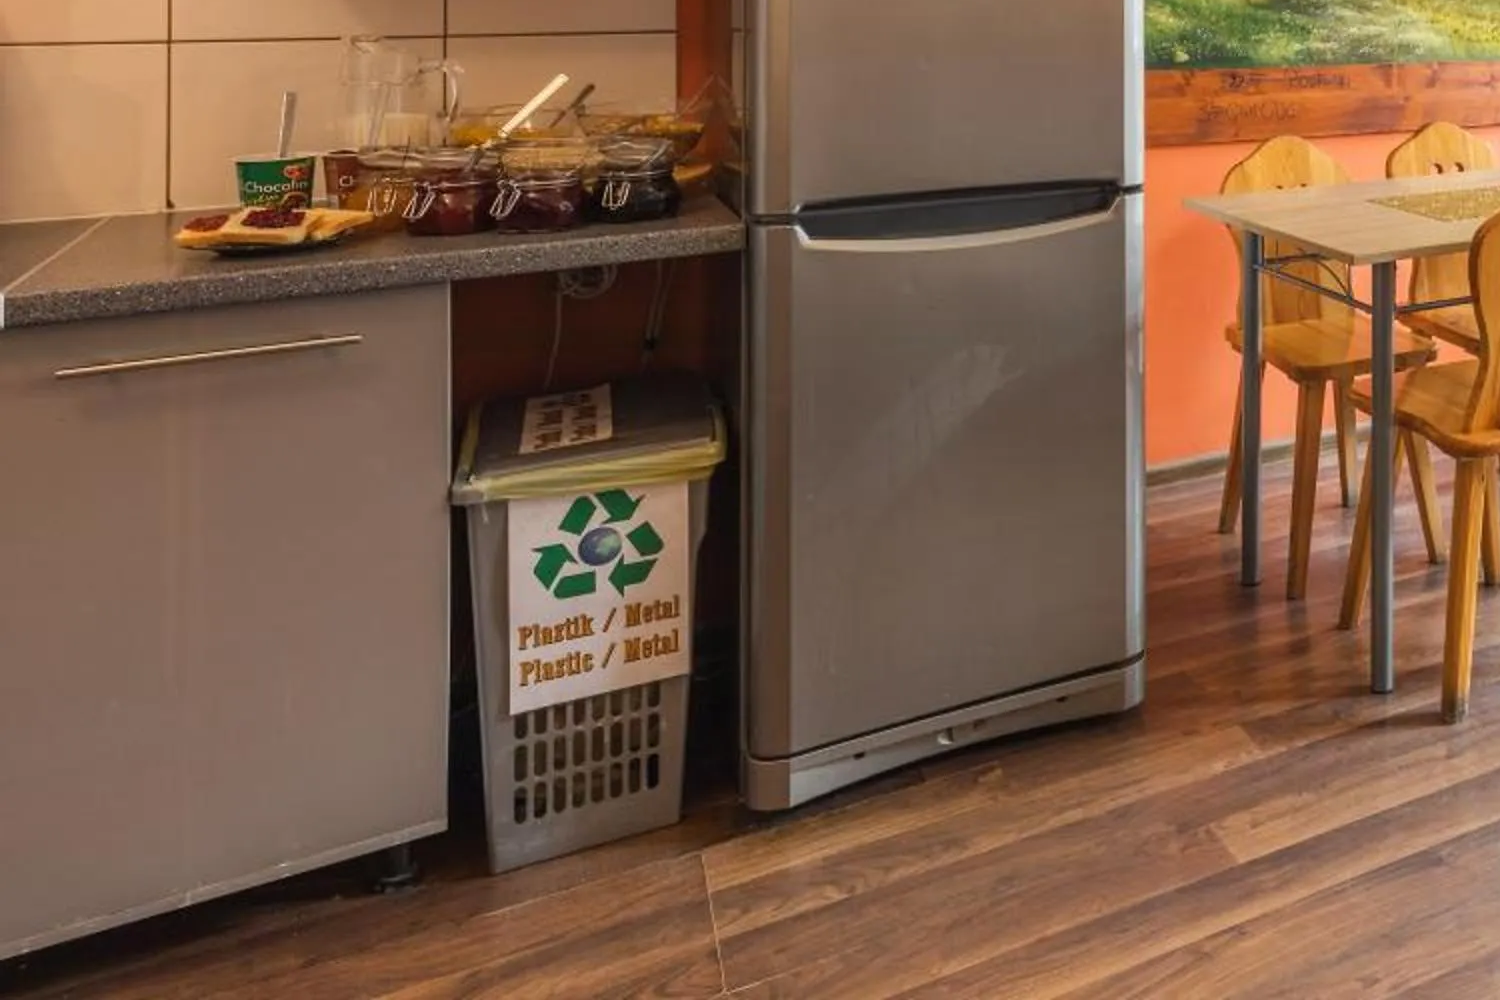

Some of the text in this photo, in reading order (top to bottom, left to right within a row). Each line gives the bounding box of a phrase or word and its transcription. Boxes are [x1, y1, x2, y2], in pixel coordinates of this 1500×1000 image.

[517, 613, 595, 651] Plastik
[624, 594, 680, 628] Metal
[518, 651, 595, 687] Plastic
[623, 628, 680, 664] Metal
